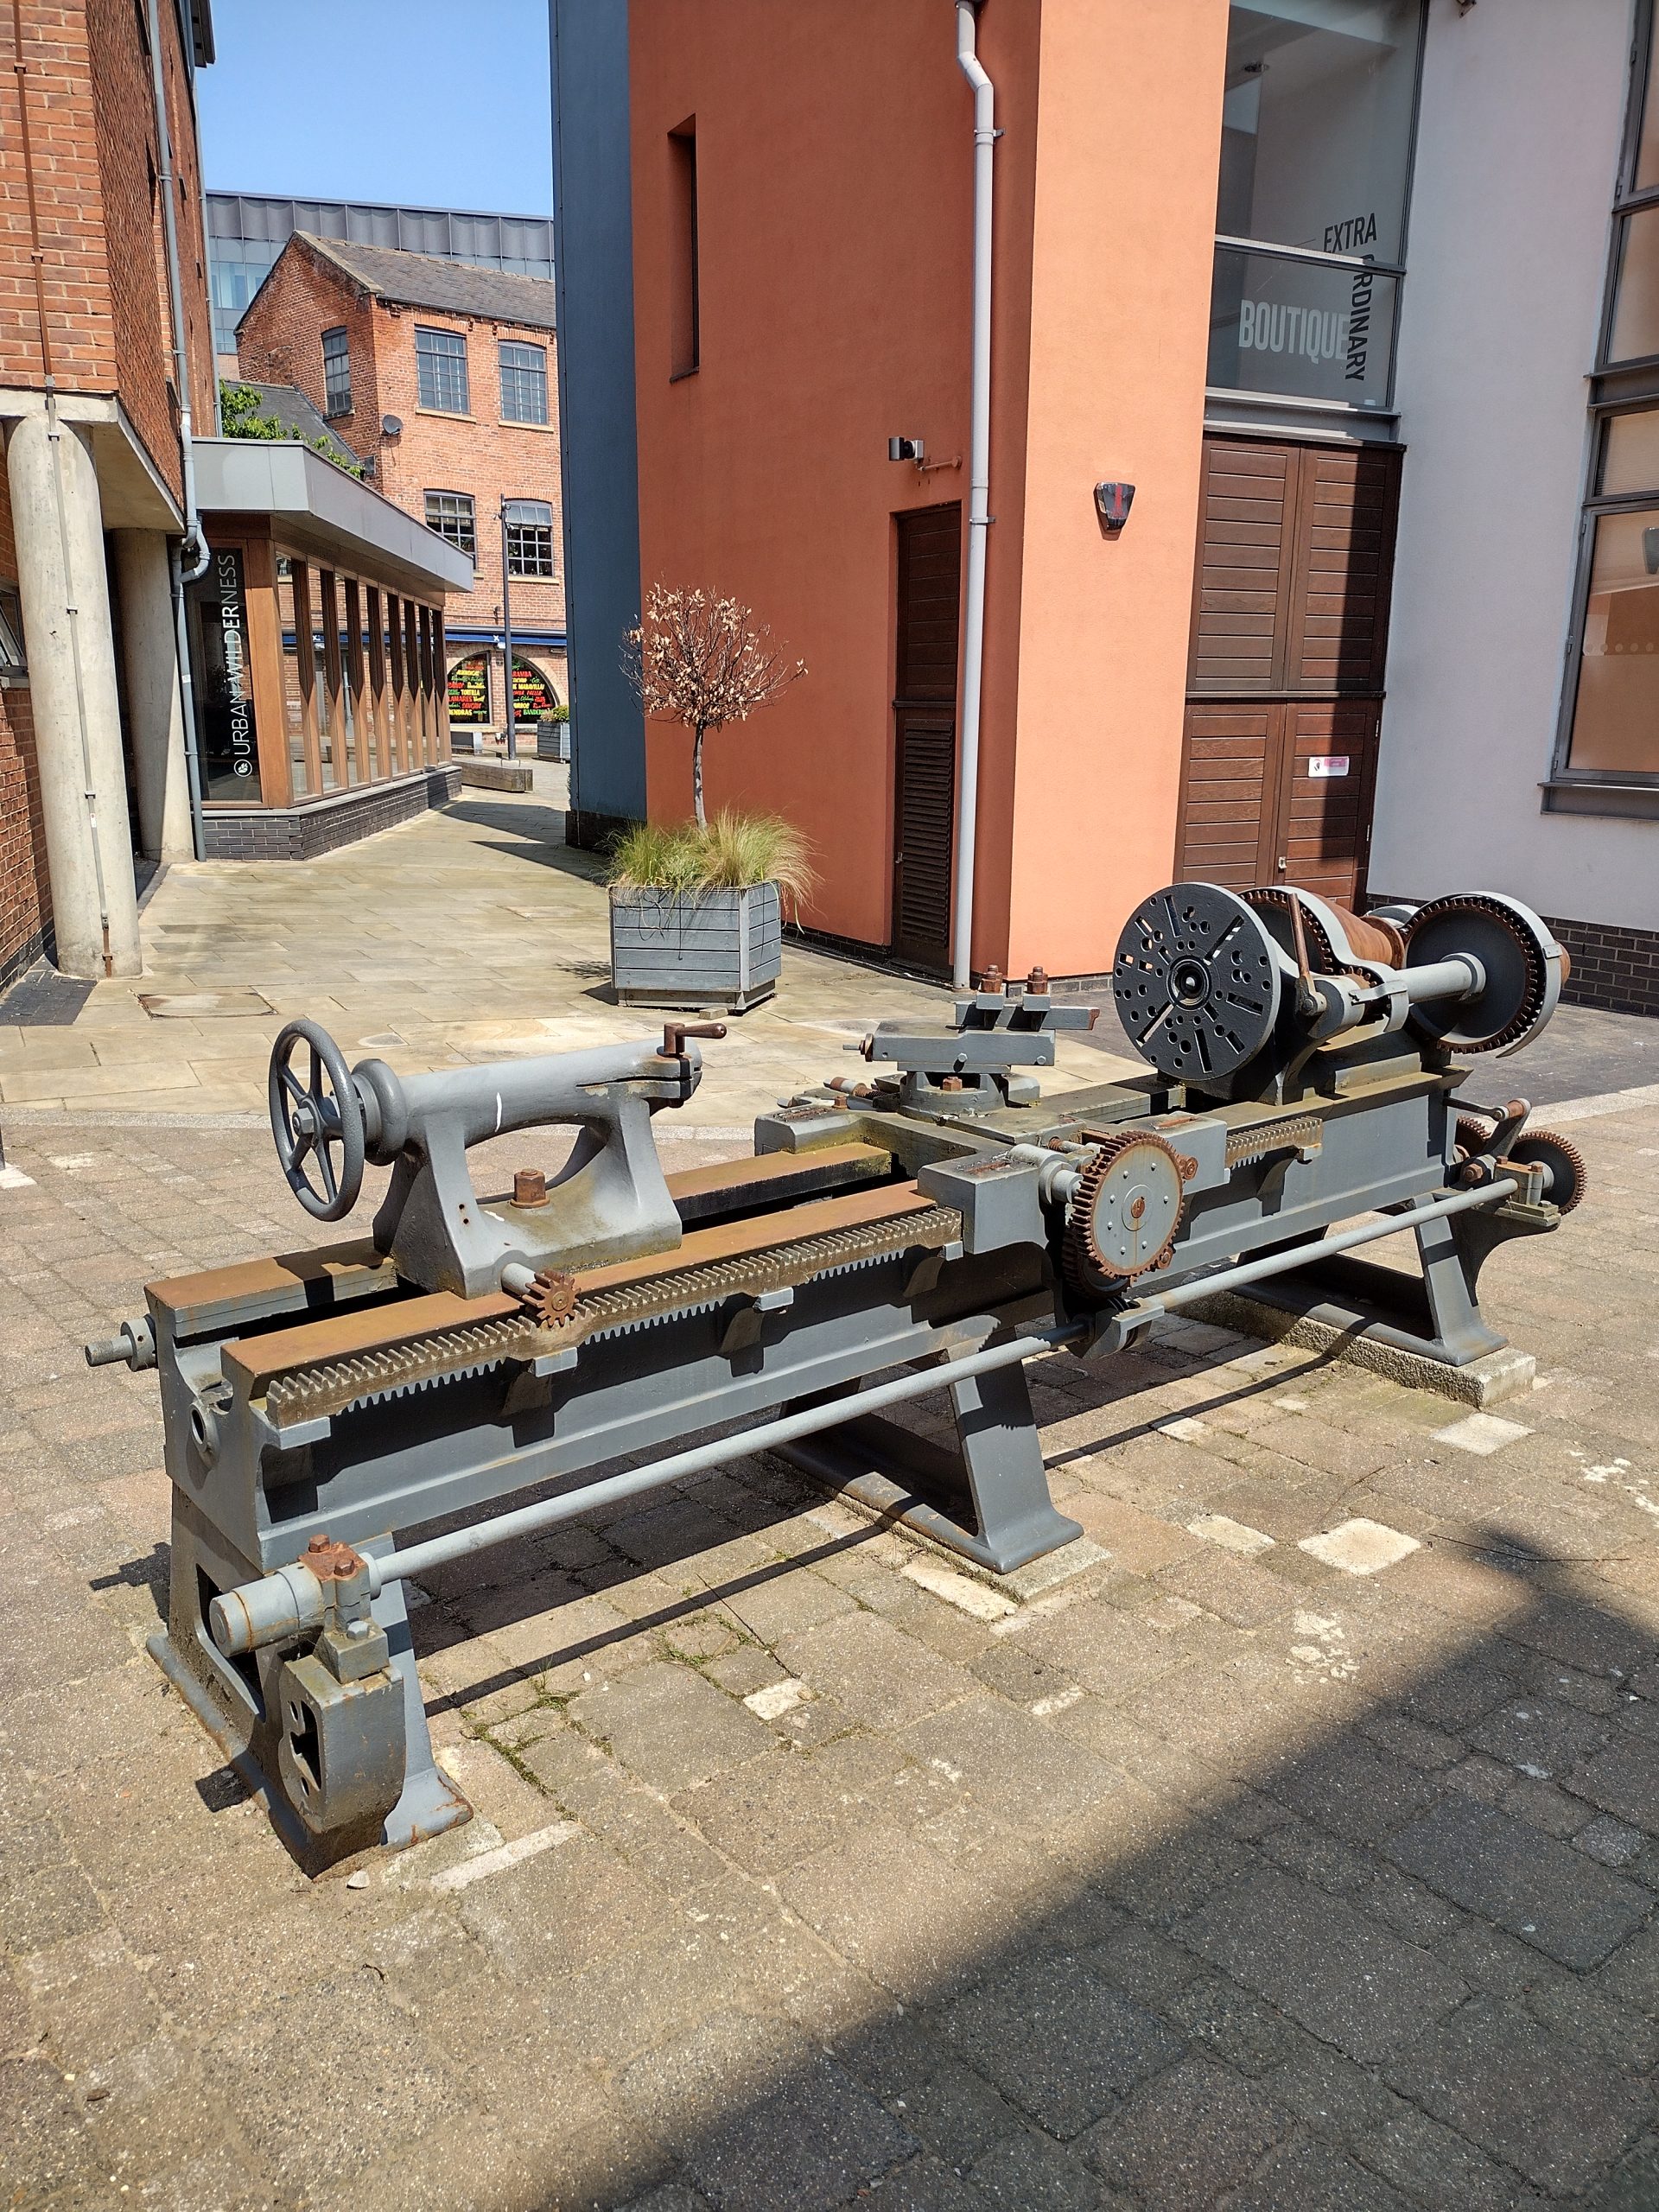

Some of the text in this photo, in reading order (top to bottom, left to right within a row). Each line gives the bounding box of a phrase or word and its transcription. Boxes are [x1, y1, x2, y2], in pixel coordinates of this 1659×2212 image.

[1324, 213, 1377, 254] EXTRA
[1238, 299, 1351, 364] BOUTIQUE
[217, 554, 251, 755] URBAN WILDERNESS
